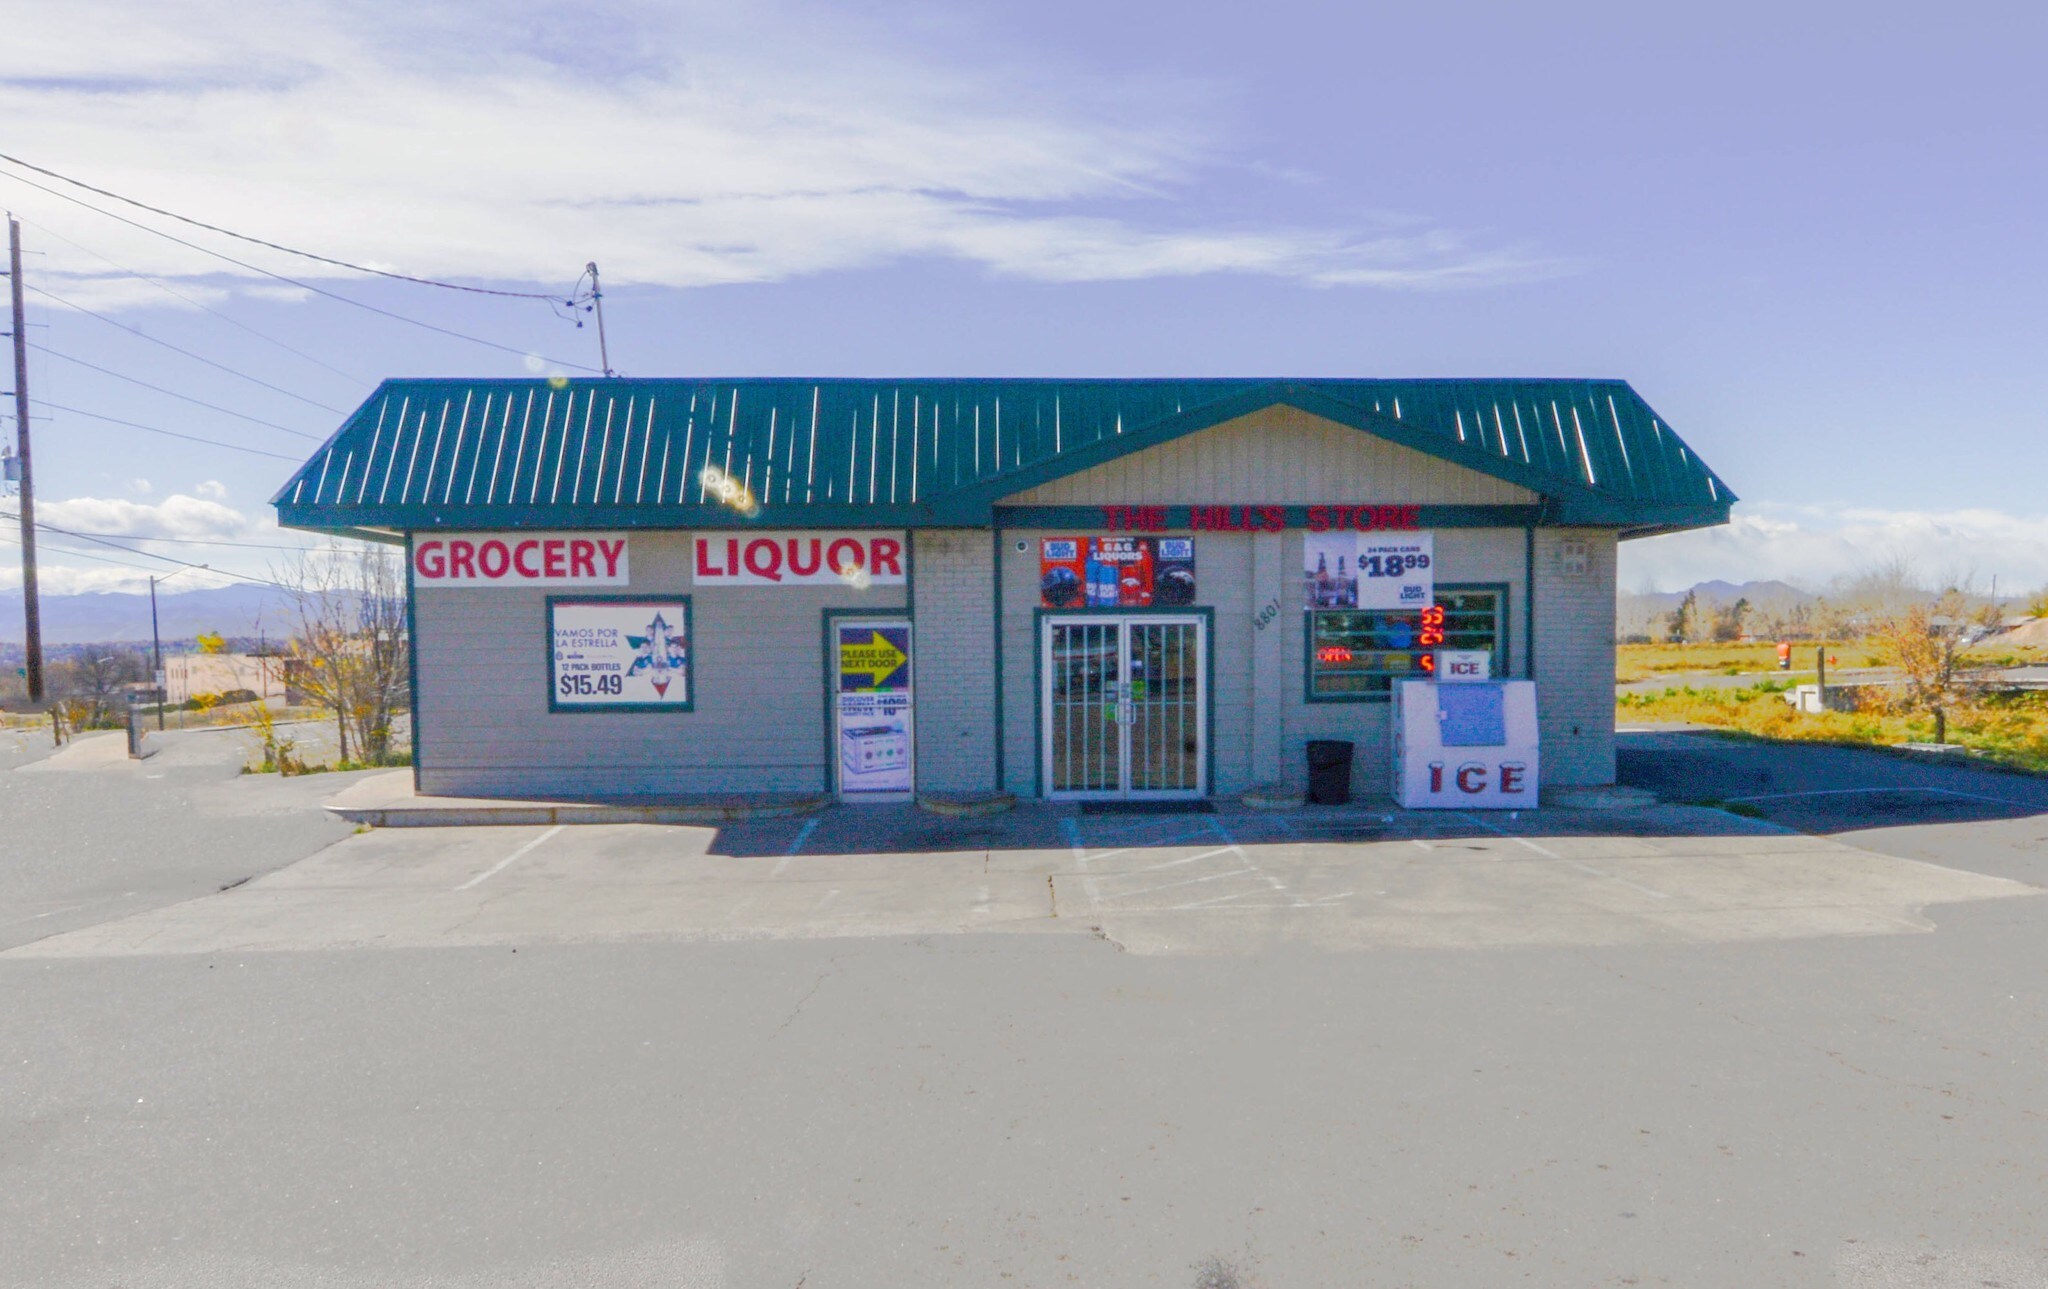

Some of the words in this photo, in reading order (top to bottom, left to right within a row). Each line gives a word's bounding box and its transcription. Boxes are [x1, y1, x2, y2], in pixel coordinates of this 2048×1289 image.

[1102, 505, 1168, 532] THE
[1308, 504, 1421, 532] STORE
[1165, 541, 1185, 549] BUD
[1046, 549, 1074, 557] LIGHT
[1093, 552, 1143, 561] LIQUORS
[1161, 549, 1190, 557] LIGHT
[415, 539, 625, 579] GROCERY
[696, 537, 902, 582] LIQUOR
[1253, 598, 1280, 631] 8801
[555, 628, 594, 638] VAMOS
[597, 628, 618, 638] POR
[555, 638, 568, 648] LA
[571, 638, 618, 648] ESTRELLA
[841, 650, 876, 658] PLEASE
[879, 650, 896, 658] USE
[562, 663, 570, 671] 12
[571, 663, 590, 671] PACK
[591, 663, 621, 671] BOTTLES
[841, 660, 865, 668] NEXT
[868, 660, 897, 668] DOOR
[1450, 663, 1480, 674] ICE
[560, 673, 622, 697] $15.49
[1428, 761, 1527, 794] ICE
